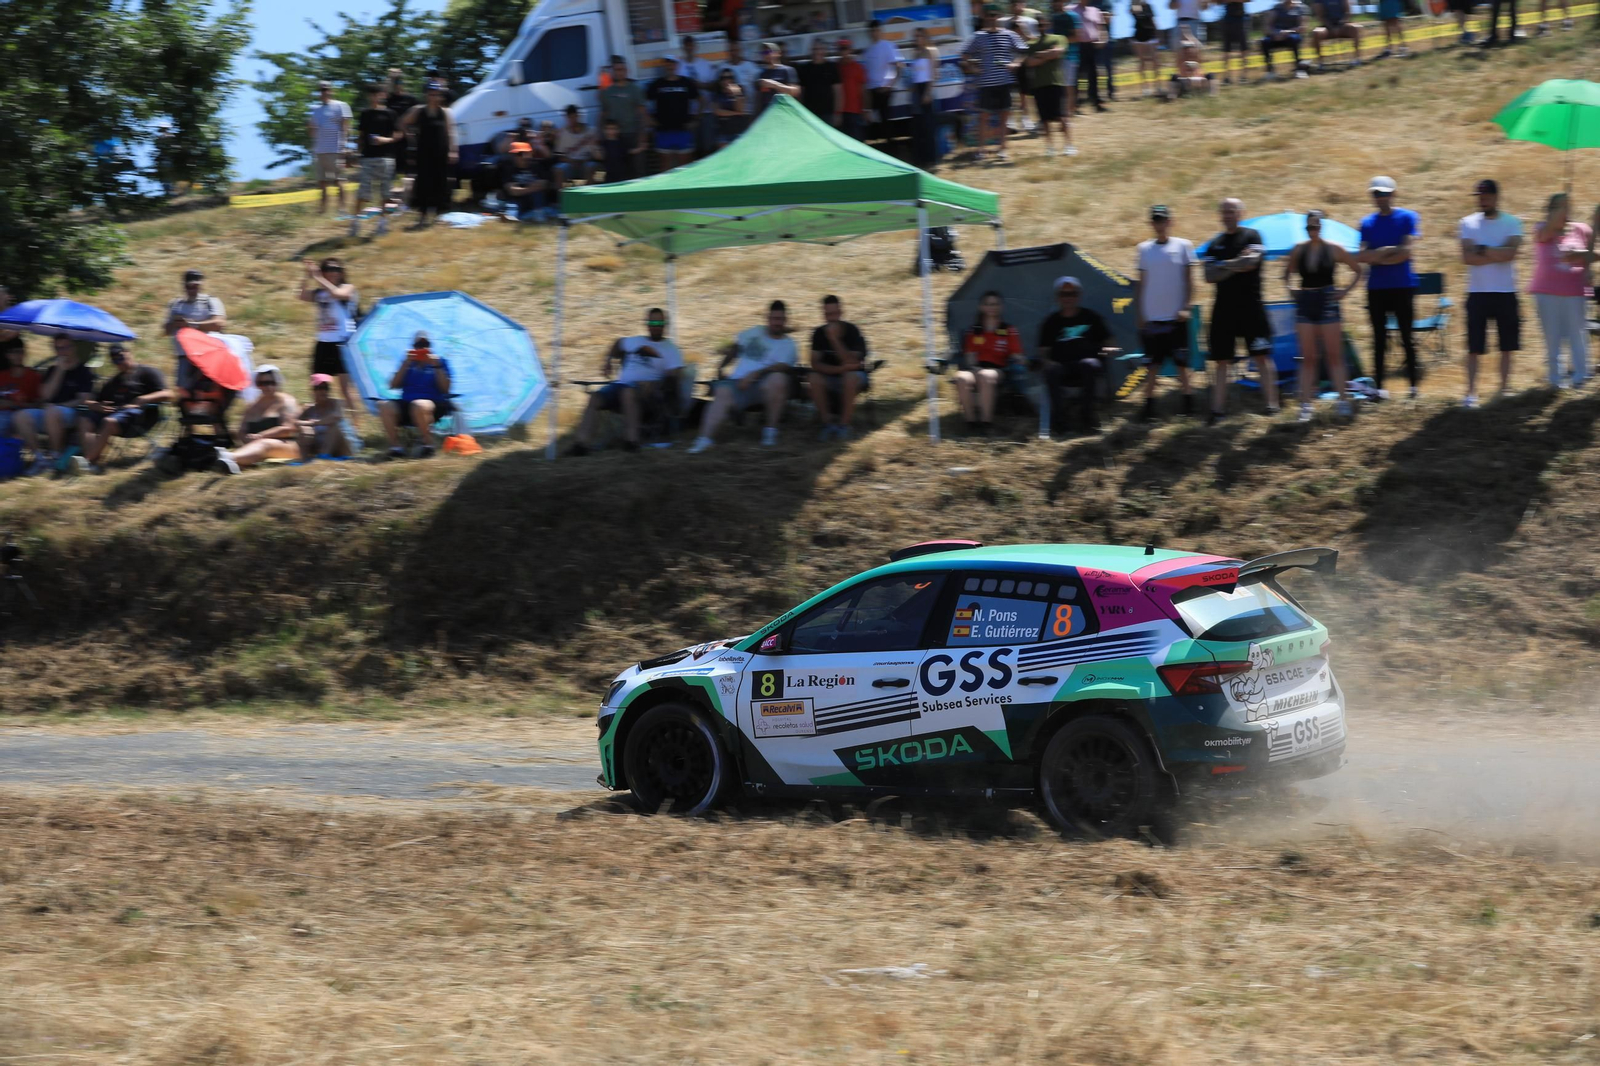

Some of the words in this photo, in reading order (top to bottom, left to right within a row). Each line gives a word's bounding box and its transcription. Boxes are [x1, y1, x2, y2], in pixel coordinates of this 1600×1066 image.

[974, 609, 985, 621] N.
[989, 609, 1017, 621] Pons
[1053, 604, 1073, 636] 8
[971, 625, 981, 637] E.
[985, 625, 1039, 637] Gutiérrez
[786, 676, 805, 688] La
[808, 674, 855, 689] Región
[920, 648, 1014, 696] GSS
[760, 673, 776, 697] 8
[922, 700, 963, 713] Subsea
[966, 693, 1013, 707] Services
[1273, 690, 1319, 711] MICHELIN
[1294, 716, 1320, 744] GSS
